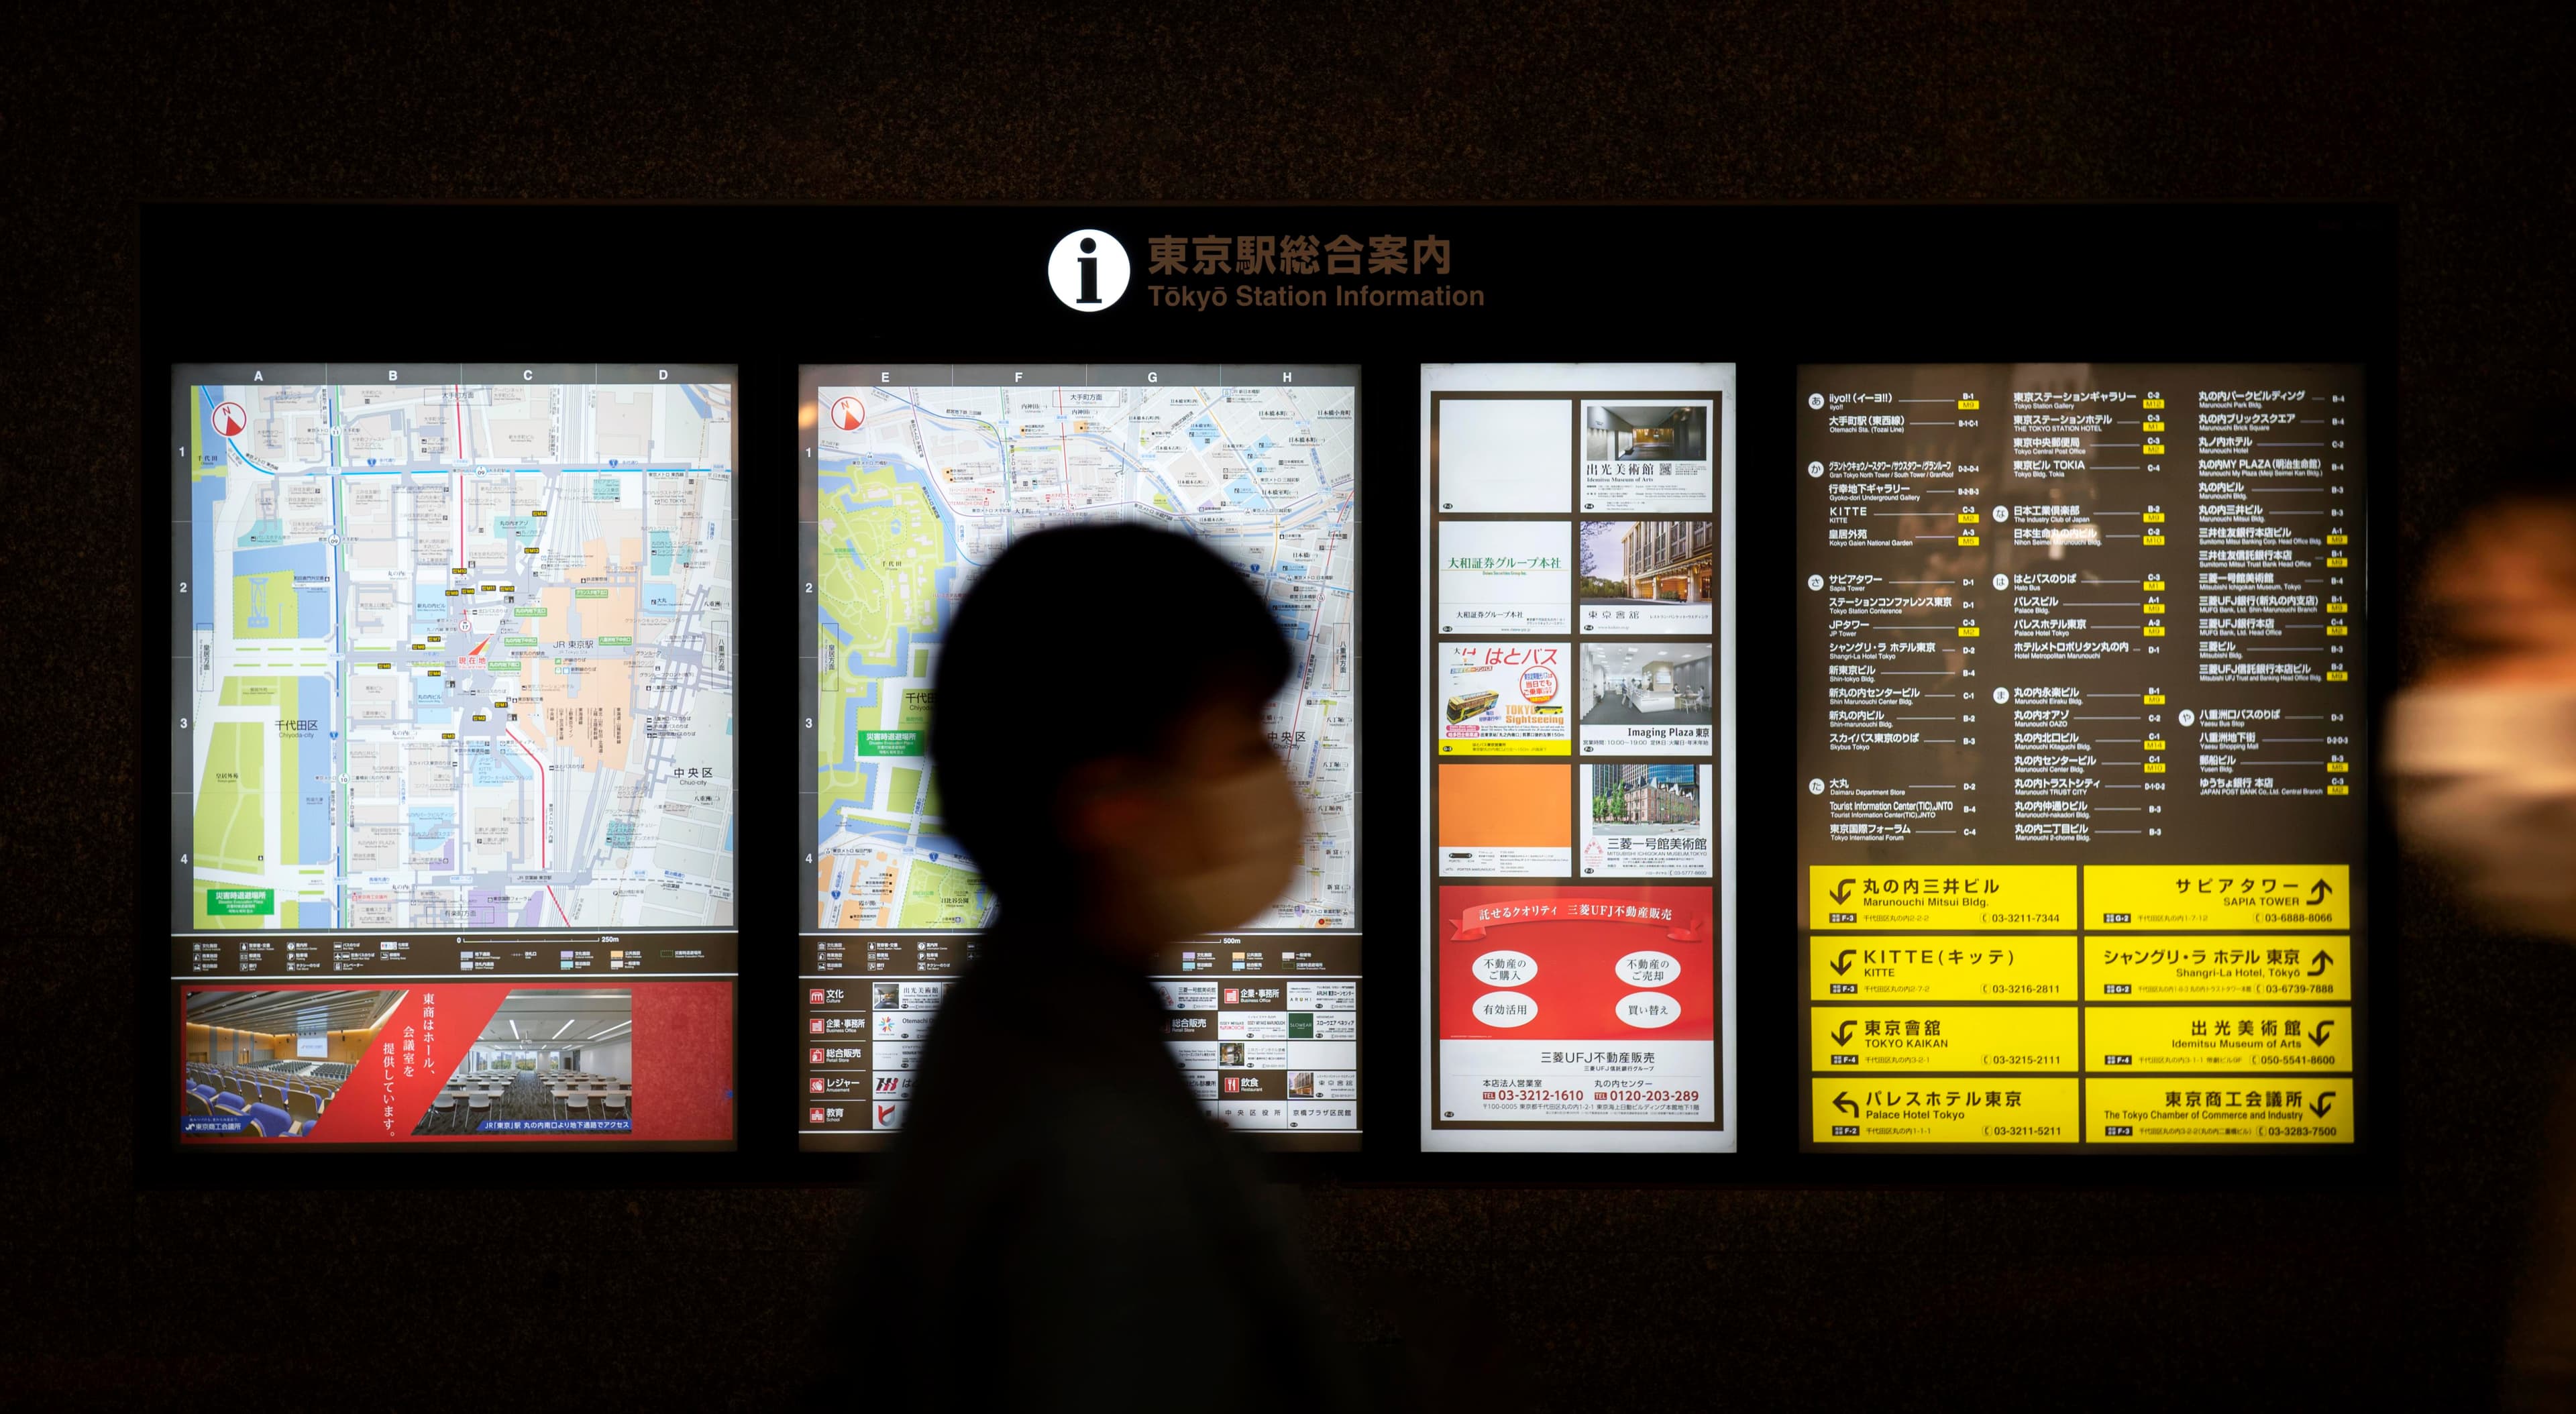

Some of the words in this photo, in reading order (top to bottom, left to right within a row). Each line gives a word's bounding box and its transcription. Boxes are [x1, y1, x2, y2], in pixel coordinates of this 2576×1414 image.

[1148, 234, 1450, 275] 東京駅総合案内
[1236, 285, 1326, 306] Station
[1337, 285, 1484, 306] Information
[254, 371, 263, 381] A
[389, 370, 397, 380] B
[524, 370, 532, 380] C
[659, 370, 667, 380] D
[882, 372, 890, 382] E
[1016, 372, 1022, 382] F
[1148, 372, 1157, 382] G
[1283, 372, 1291, 382] H
[1071, 394, 1102, 402] 大手町方面
[2014, 392, 2136, 402] 東京ステーションギャラリー
[2199, 390, 2305, 402] 丸の内パークビルディング
[2014, 437, 2080, 449] 東京中央郵便局
[180, 447, 184, 456] 1
[806, 447, 810, 457] 1
[1587, 464, 1654, 475] 出光美術館
[1829, 484, 1910, 494] 行幸地下ギャラリー
[2199, 482, 2244, 492] 丸の内ビル
[1830, 507, 1866, 516] KITTE
[1829, 529, 1867, 539] 皇居外苑
[1448, 557, 1562, 569] 大和証券グループ本社
[1829, 574, 1882, 584] サピアタワー
[2014, 574, 2076, 584] はとバスのりば
[180, 582, 186, 592] 2
[806, 583, 812, 592] 2
[1830, 596, 1952, 607] ステーションコンファレンス東京
[1829, 620, 1869, 629] JPタワー
[2014, 619, 2086, 629] パレスホテル東京
[569, 641, 593, 649] 東京駅
[460, 655, 486, 664] 現在地
[1485, 648, 1557, 667] はとバス
[1829, 665, 1876, 675] 新東京ビル
[2015, 710, 2070, 720] 丸の内オアゾ
[180, 718, 187, 728] 3
[276, 720, 318, 731] 千代田区
[806, 718, 812, 728] 3
[1506, 715, 1564, 726] Sightseeing
[279, 730, 314, 740] Chiyoda-city
[1267, 731, 1306, 743] 中央区
[1628, 728, 1666, 739] Imaging
[1670, 728, 1693, 736] Plaza
[1696, 728, 1709, 737] 東京
[674, 767, 712, 778] 中央区
[1829, 778, 1849, 788] 大丸
[2015, 778, 2100, 790] 丸の内トラストシティ
[1830, 824, 1911, 834] 東京国際フォーラム
[1608, 838, 1707, 850] 三菱一号館美術館
[181, 854, 188, 864] 4
[806, 854, 812, 863] 4
[1864, 878, 1999, 894] 丸の内三井ビル
[2176, 879, 2298, 893] サピアタワー
[1864, 898, 1924, 906] Marunouchi
[1963, 898, 1988, 908] Bldg.
[2224, 898, 2255, 906] SAPIA
[2261, 898, 2299, 906] TOWER
[1479, 906, 1558, 922] 託せるクオリティ
[1568, 904, 1671, 920] 三菱UFJ不動産販売
[1992, 914, 2059, 922] 03-3211-7344
[2265, 913, 2332, 922] 03-6888-8066
[2104, 950, 2206, 965] シャングリ・ラ
[2214, 950, 2260, 964] ホテル
[2267, 949, 2299, 965] 東京
[1485, 959, 1525, 969] 不動産の
[1628, 959, 1669, 969] 不動産の
[1490, 971, 1520, 980] ご購入
[1633, 971, 1664, 981] ご売却
[1865, 969, 1894, 977] KITTE
[2177, 969, 2232, 979] Shangri-La
[2235, 969, 2264, 977] Hotel,
[1992, 985, 2059, 993] 03-3216-2811
[2266, 984, 2333, 993] 03-6739-7888
[826, 989, 844, 999] 文化
[1484, 1005, 1526, 1015] 有効活用
[1629, 1005, 1668, 1015] 買い替え
[1865, 1020, 1940, 1036] 東京會舘
[2192, 1020, 2300, 1036] 出光美術館
[423, 993, 435, 1074] 東商はホール、
[1866, 1039, 1902, 1048] TOKYO
[2172, 1040, 2216, 1048] Idemitsu
[2220, 1040, 2263, 1048] Museum
[2267, 1040, 2276, 1048] of
[2280, 1040, 2301, 1048] Arts
[403, 1026, 415, 1077] 会議室を
[826, 1048, 861, 1059] 総合販売
[1542, 1052, 1654, 1063] 三菱UFJ不動産販売
[1993, 1056, 2059, 1064] 03-3215-2111
[2261, 1056, 2336, 1065] 050-5541-8600
[828, 1079, 859, 1087] レジャー
[1241, 1078, 1258, 1087] 飲食
[1483, 1079, 1542, 1087] 本店法人営業室
[1595, 1080, 1652, 1088] 丸の内センター
[383, 1042, 396, 1136] 提供しています。
[1483, 1091, 1495, 1099] TEL
[1499, 1090, 1583, 1101] 03-3212-1610
[1611, 1091, 1699, 1101] 0120-203-289
[1866, 1091, 2021, 1107] パレスホテル東京
[2166, 1091, 2302, 1108] 東京商工会議所
[826, 1108, 843, 1119] 教育
[1224, 1109, 1280, 1118] 中央区役所
[1866, 1110, 1900, 1119] Palace
[1903, 1111, 1929, 1119] Hotel
[1933, 1110, 1964, 1121] Tokyo
[2104, 1110, 2120, 1119] The
[2123, 1111, 2148, 1121] Tokyo
[2151, 1111, 2188, 1119] Chamber
[2191, 1111, 2199, 1119] of
[2202, 1111, 2247, 1120] Commerce
[2250, 1111, 2265, 1119] and
[2268, 1111, 2303, 1122] Industry
[485, 1120, 521, 1129] JR「東京」駅
[524, 1119, 629, 1129] 丸の内南口より地下通路でアクセス
[1994, 1127, 2060, 1135] 03-3211-5211
[2268, 1126, 2337, 1136] 03-3283-7500
